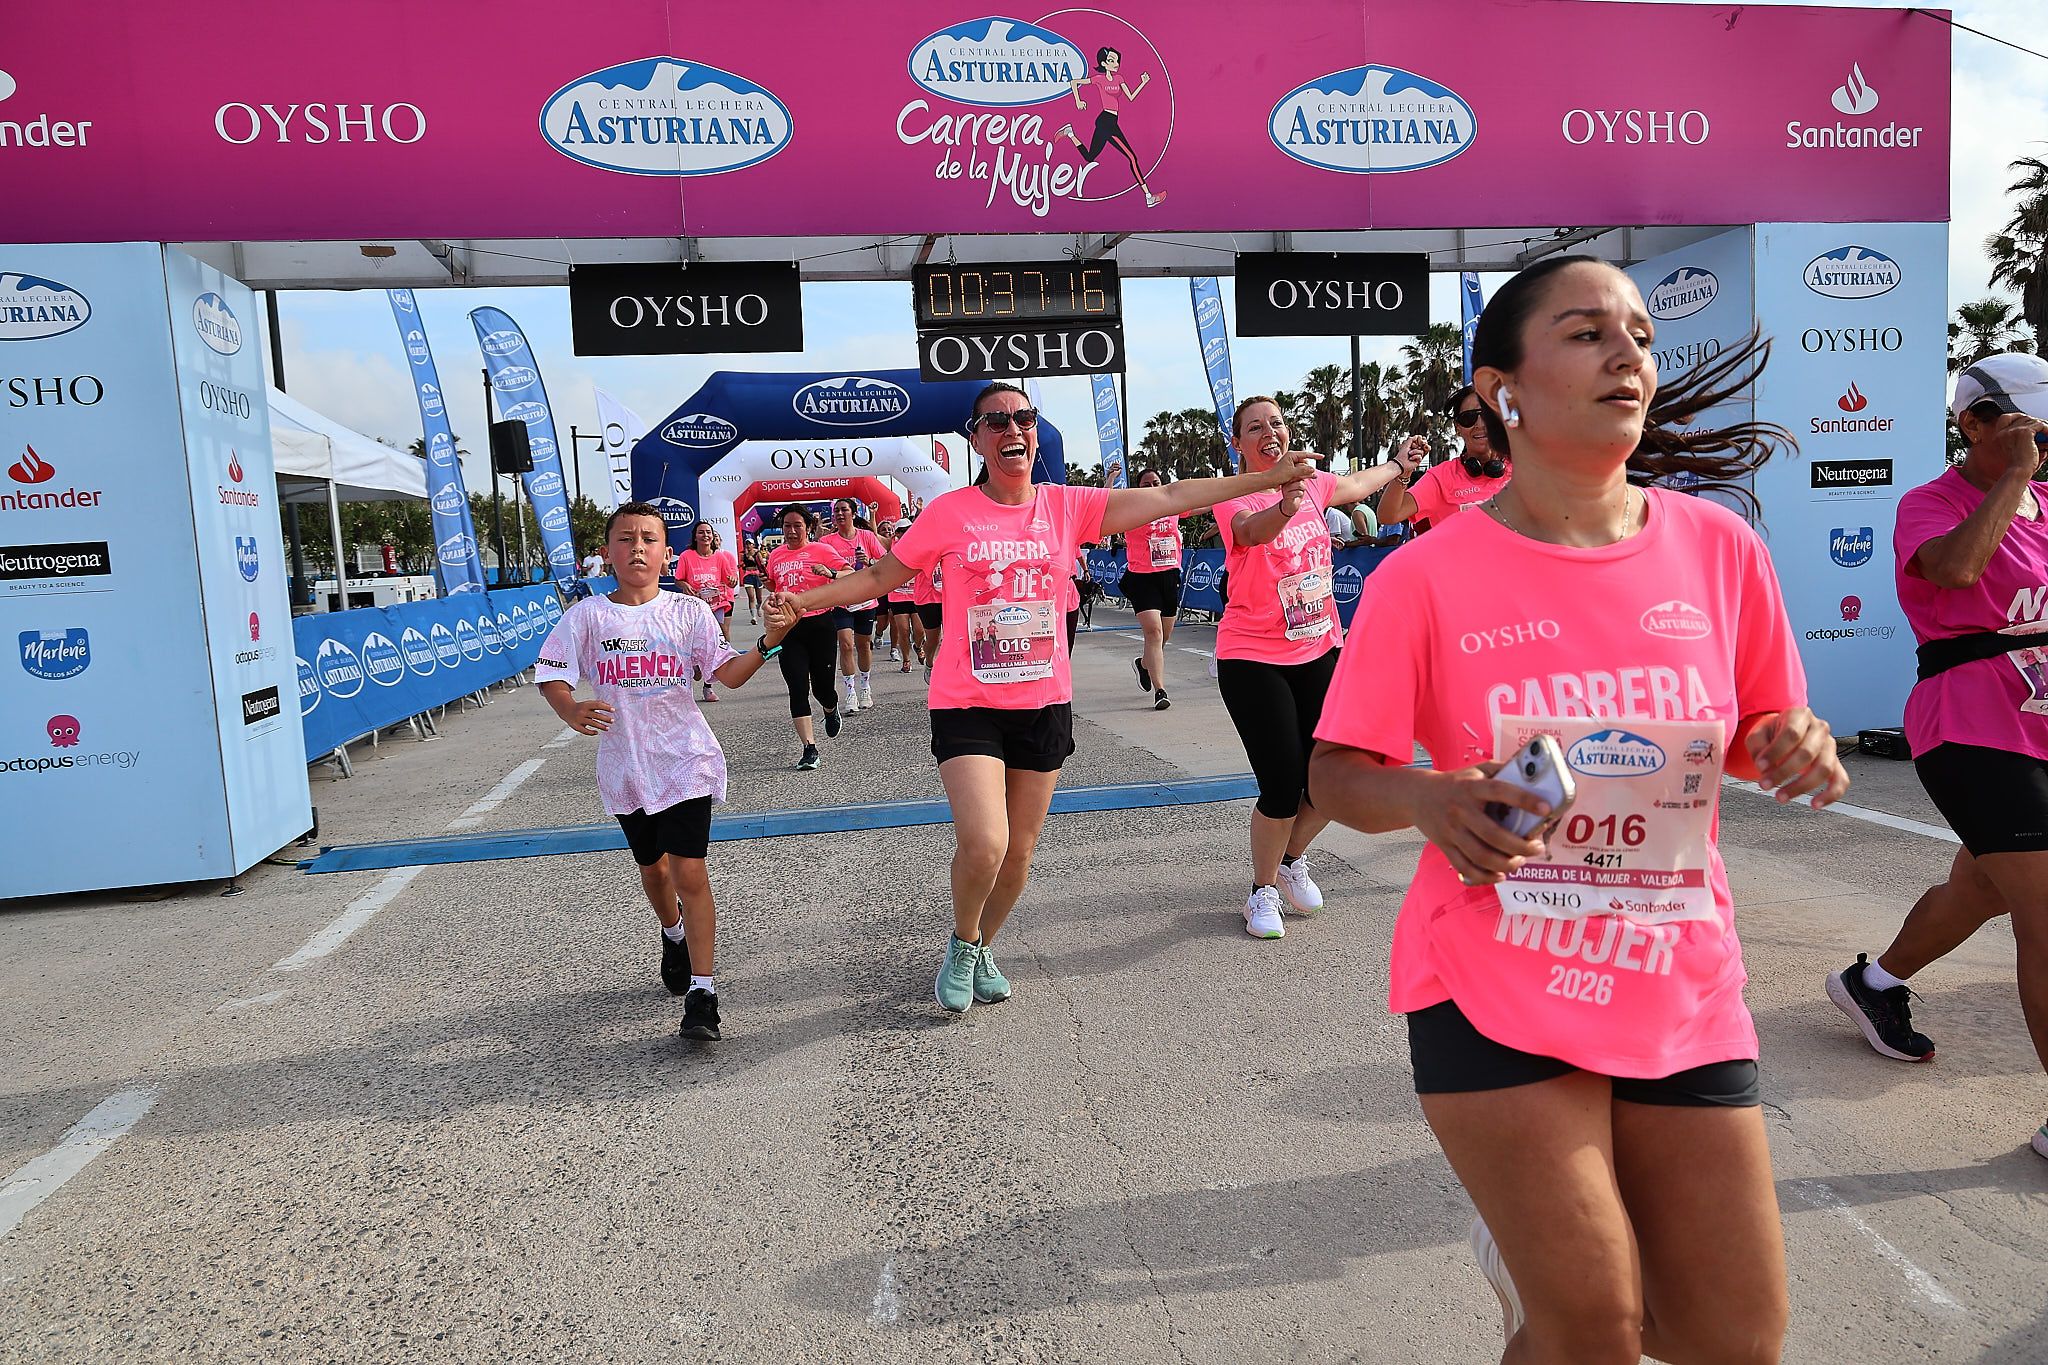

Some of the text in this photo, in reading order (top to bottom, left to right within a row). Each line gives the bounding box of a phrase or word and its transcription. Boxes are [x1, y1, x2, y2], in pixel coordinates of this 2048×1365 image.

[950, 48, 1067, 57] CENTRAL LECHERA
[924, 49, 1074, 83] ASTURIANA
[599, 99, 765, 110] CENTRAL LECHERA
[1317, 103, 1454, 113] CENTRAL LECHERA
[215, 102, 427, 145] OYSHO
[562, 101, 775, 145] ASTURIANA
[896, 99, 1044, 146] Carrera
[1286, 105, 1461, 145] ASTURIANA
[1561, 109, 1710, 145] OYSHO
[1786, 121, 1923, 149] Santander
[935, 141, 1099, 217] de la Mujer
[1810, 266, 1894, 286] ASTURIANA
[929, 270, 1105, 316] 00:37:16
[1268, 279, 1403, 311] OYSHO
[1652, 285, 1714, 313] ASTURIANA
[609, 294, 769, 329] OYSHO
[198, 308, 239, 345] ASTURIANA
[1801, 327, 1903, 353] OYSHO
[929, 330, 1115, 375] OYSHO
[0, 375, 104, 408] SHO
[201, 380, 250, 419] OYSHO
[803, 393, 902, 414] ASTURIANA
[666, 427, 731, 440] ASTURIANA
[1811, 416, 1894, 433] Santander
[771, 446, 873, 470] OYSHO
[902, 465, 933, 473] OYSHO
[710, 475, 742, 483] OYSHO
[761, 478, 850, 491] Sports Santander
[1816, 466, 1888, 484] Neutrogena
[218, 485, 259, 507] Santander
[1454, 487, 1480, 497] OYSHO
[963, 523, 998, 533] OYSHO
[1273, 519, 1328, 550] CARRERA
[967, 540, 1051, 562] CARRERA
[1832, 535, 1872, 558] Marlene
[0, 553, 101, 573] eutrogena
[1013, 568, 1037, 598] DE
[1305, 599, 1324, 614] 016
[1648, 616, 1708, 632] ASTURIANA
[1806, 625, 1896, 641] octopus energy
[999, 638, 1031, 653] 016
[1460, 620, 1560, 654] OYSHO
[24, 640, 87, 668] Marlene
[235, 649, 259, 665] octopus
[66, 665, 84, 677] ALPES
[617, 678, 686, 688] ABIERTA AL MAR
[1486, 664, 1717, 724] CARRERA
[0, 750, 140, 774] octopus energy
[1574, 748, 1657, 768] ASTURIANA
[1566, 814, 1647, 846] 016
[1584, 852, 1622, 867] 4471
[1562, 870, 1576, 881] DE
[1580, 871, 1592, 882] LA
[1596, 873, 1630, 883] MUJER
[1513, 890, 1686, 914] OYSHO Santander
[1494, 911, 1681, 976] MUJER
[1546, 965, 1614, 1006] 2026
